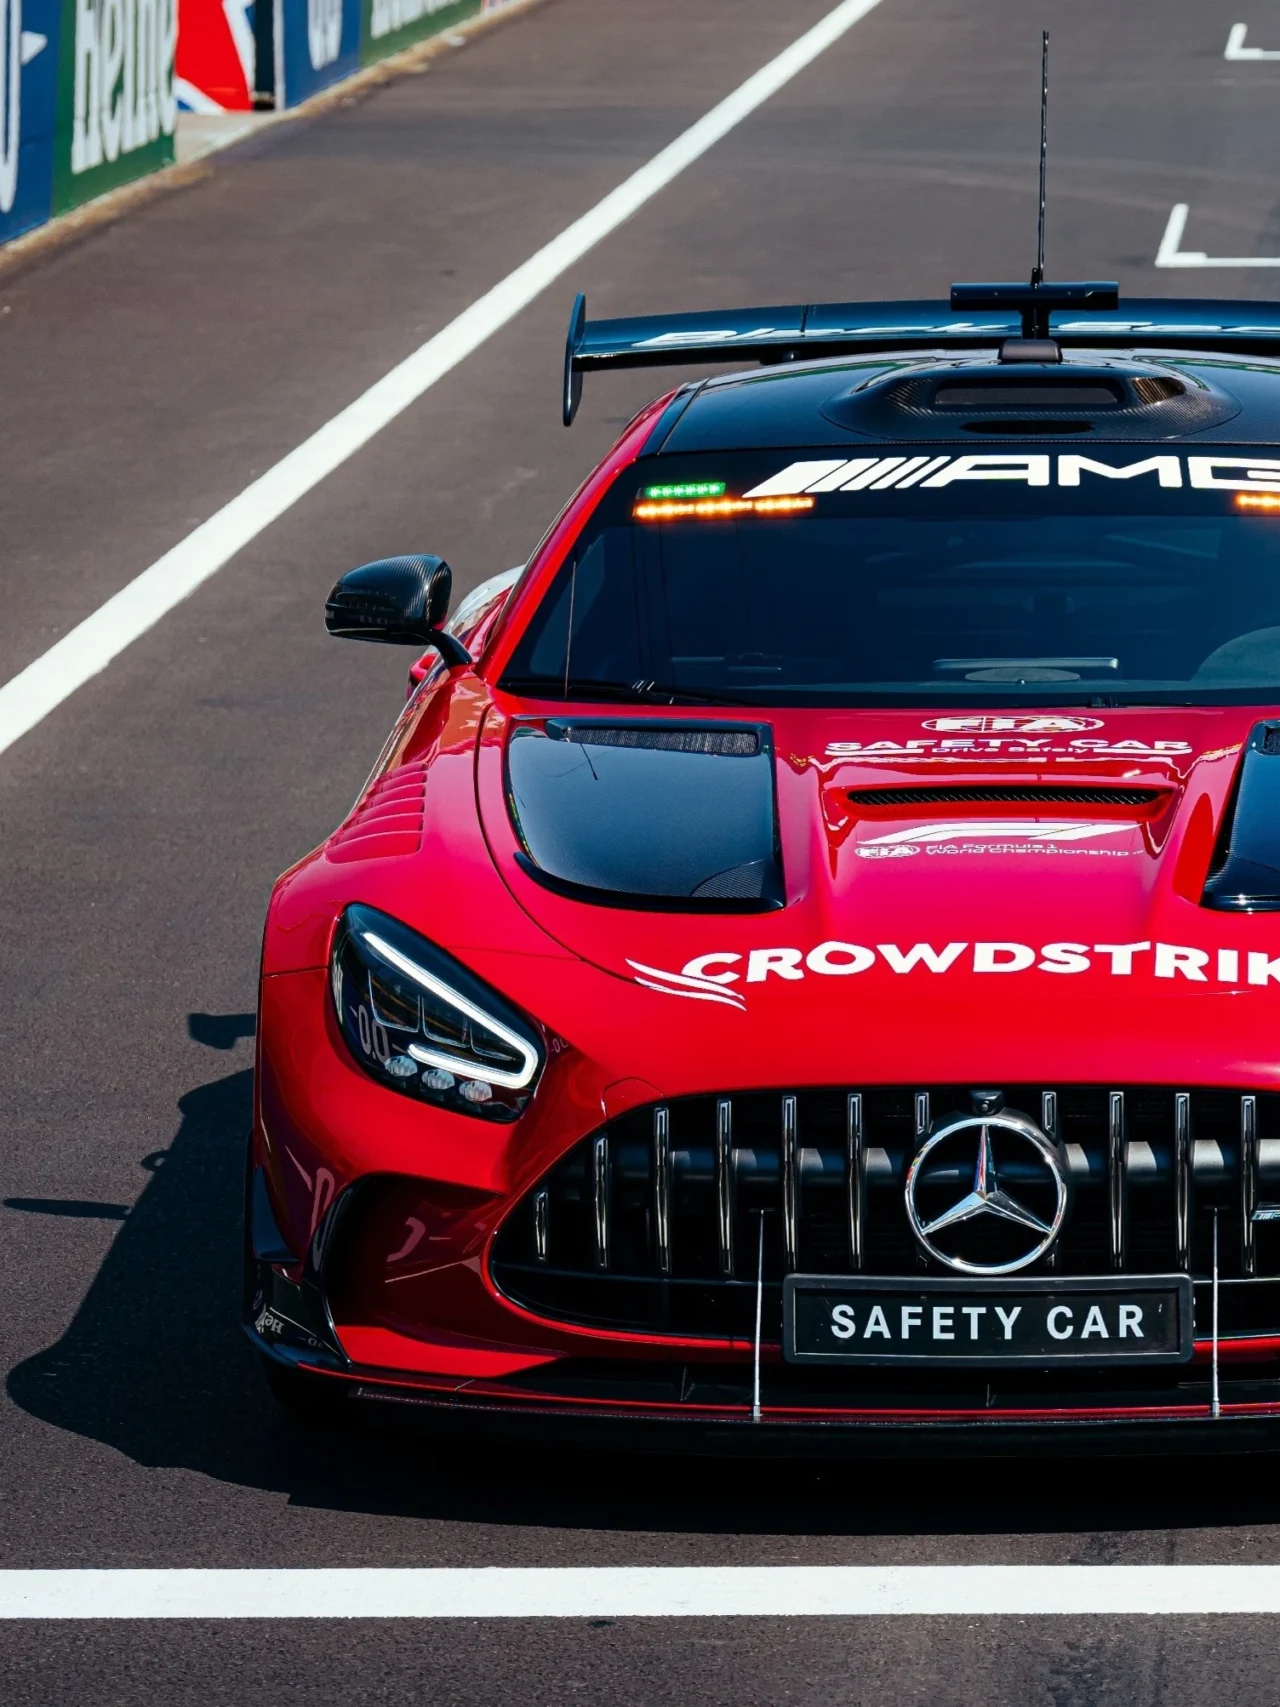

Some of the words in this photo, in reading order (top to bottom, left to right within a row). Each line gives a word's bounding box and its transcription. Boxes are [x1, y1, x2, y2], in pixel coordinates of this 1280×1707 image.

[933, 717, 1080, 732] FIA
[826, 738, 1054, 750] SAFETY
[1069, 738, 1192, 750] CAR
[978, 848, 1129, 857] Championship
[831, 1304, 1022, 1340] SAFETY
[1046, 1304, 1144, 1340] CAR
